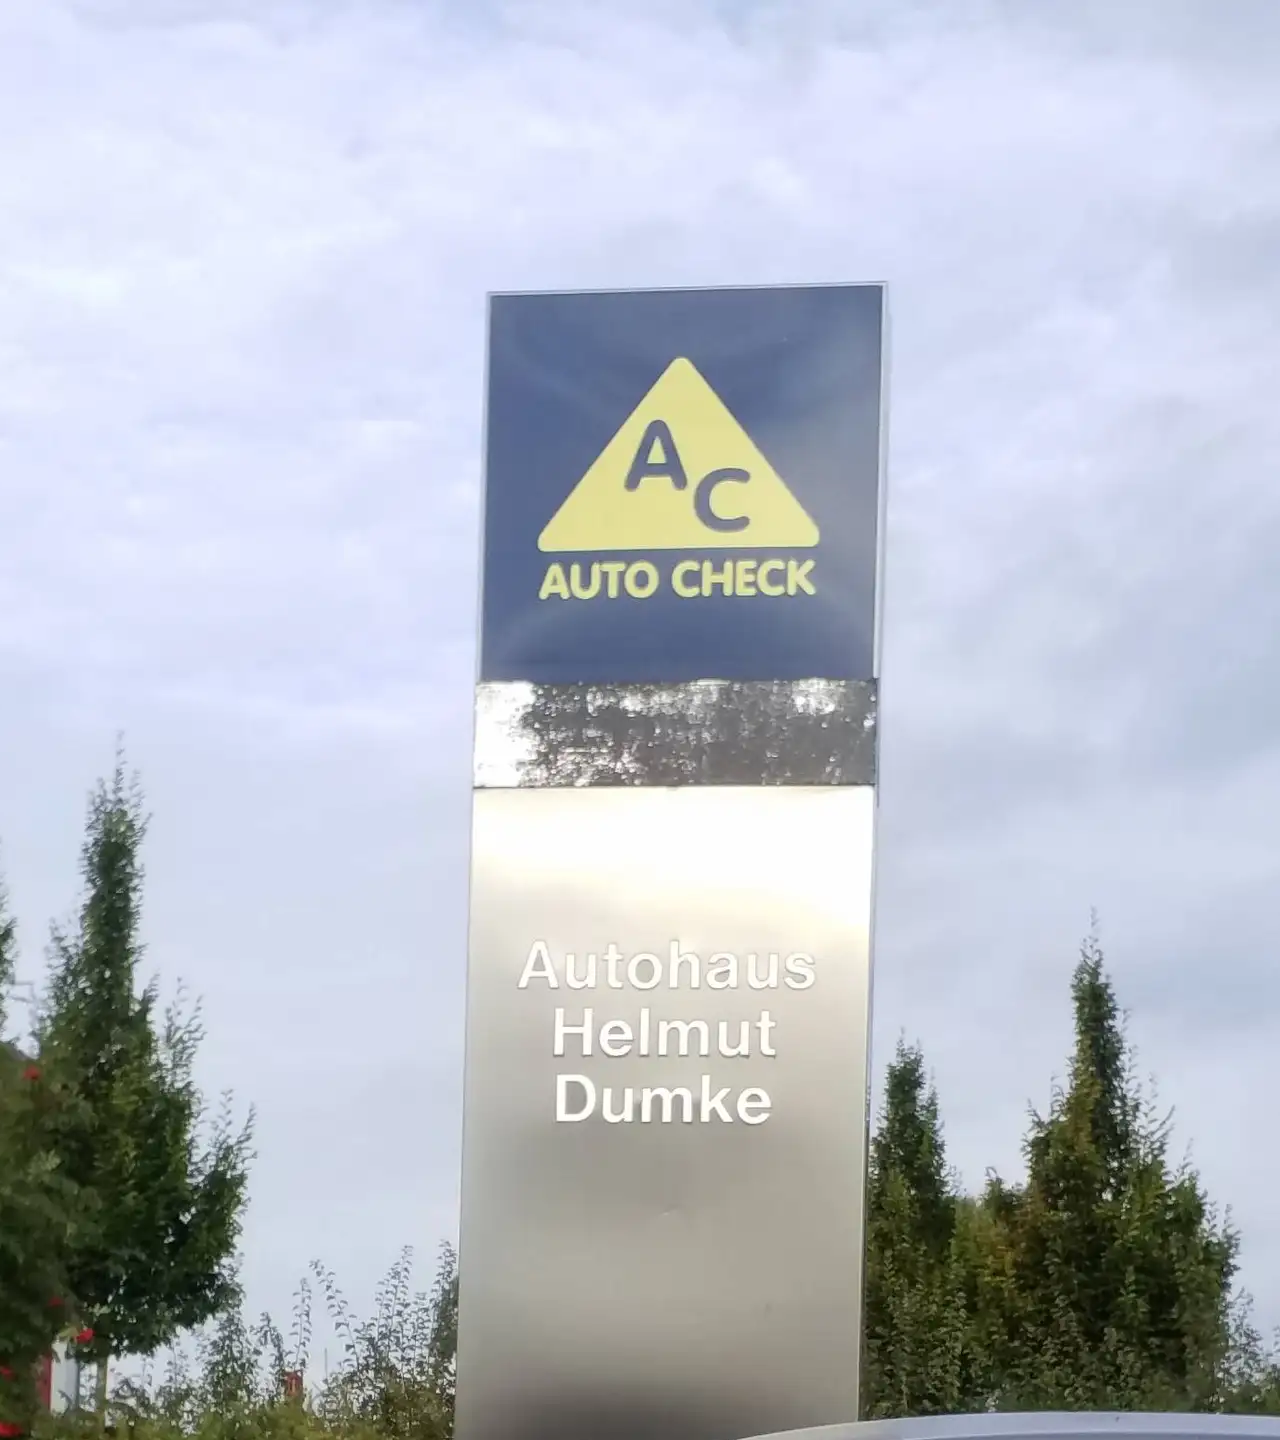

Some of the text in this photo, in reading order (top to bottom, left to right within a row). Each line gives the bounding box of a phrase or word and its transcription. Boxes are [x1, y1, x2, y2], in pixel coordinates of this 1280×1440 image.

[624, 419, 751, 533] AC
[539, 559, 817, 600] AUTO CHECK
[517, 940, 816, 990] Autohaus
[553, 1007, 776, 1057] Helmut
[555, 1074, 772, 1125] Dumke
